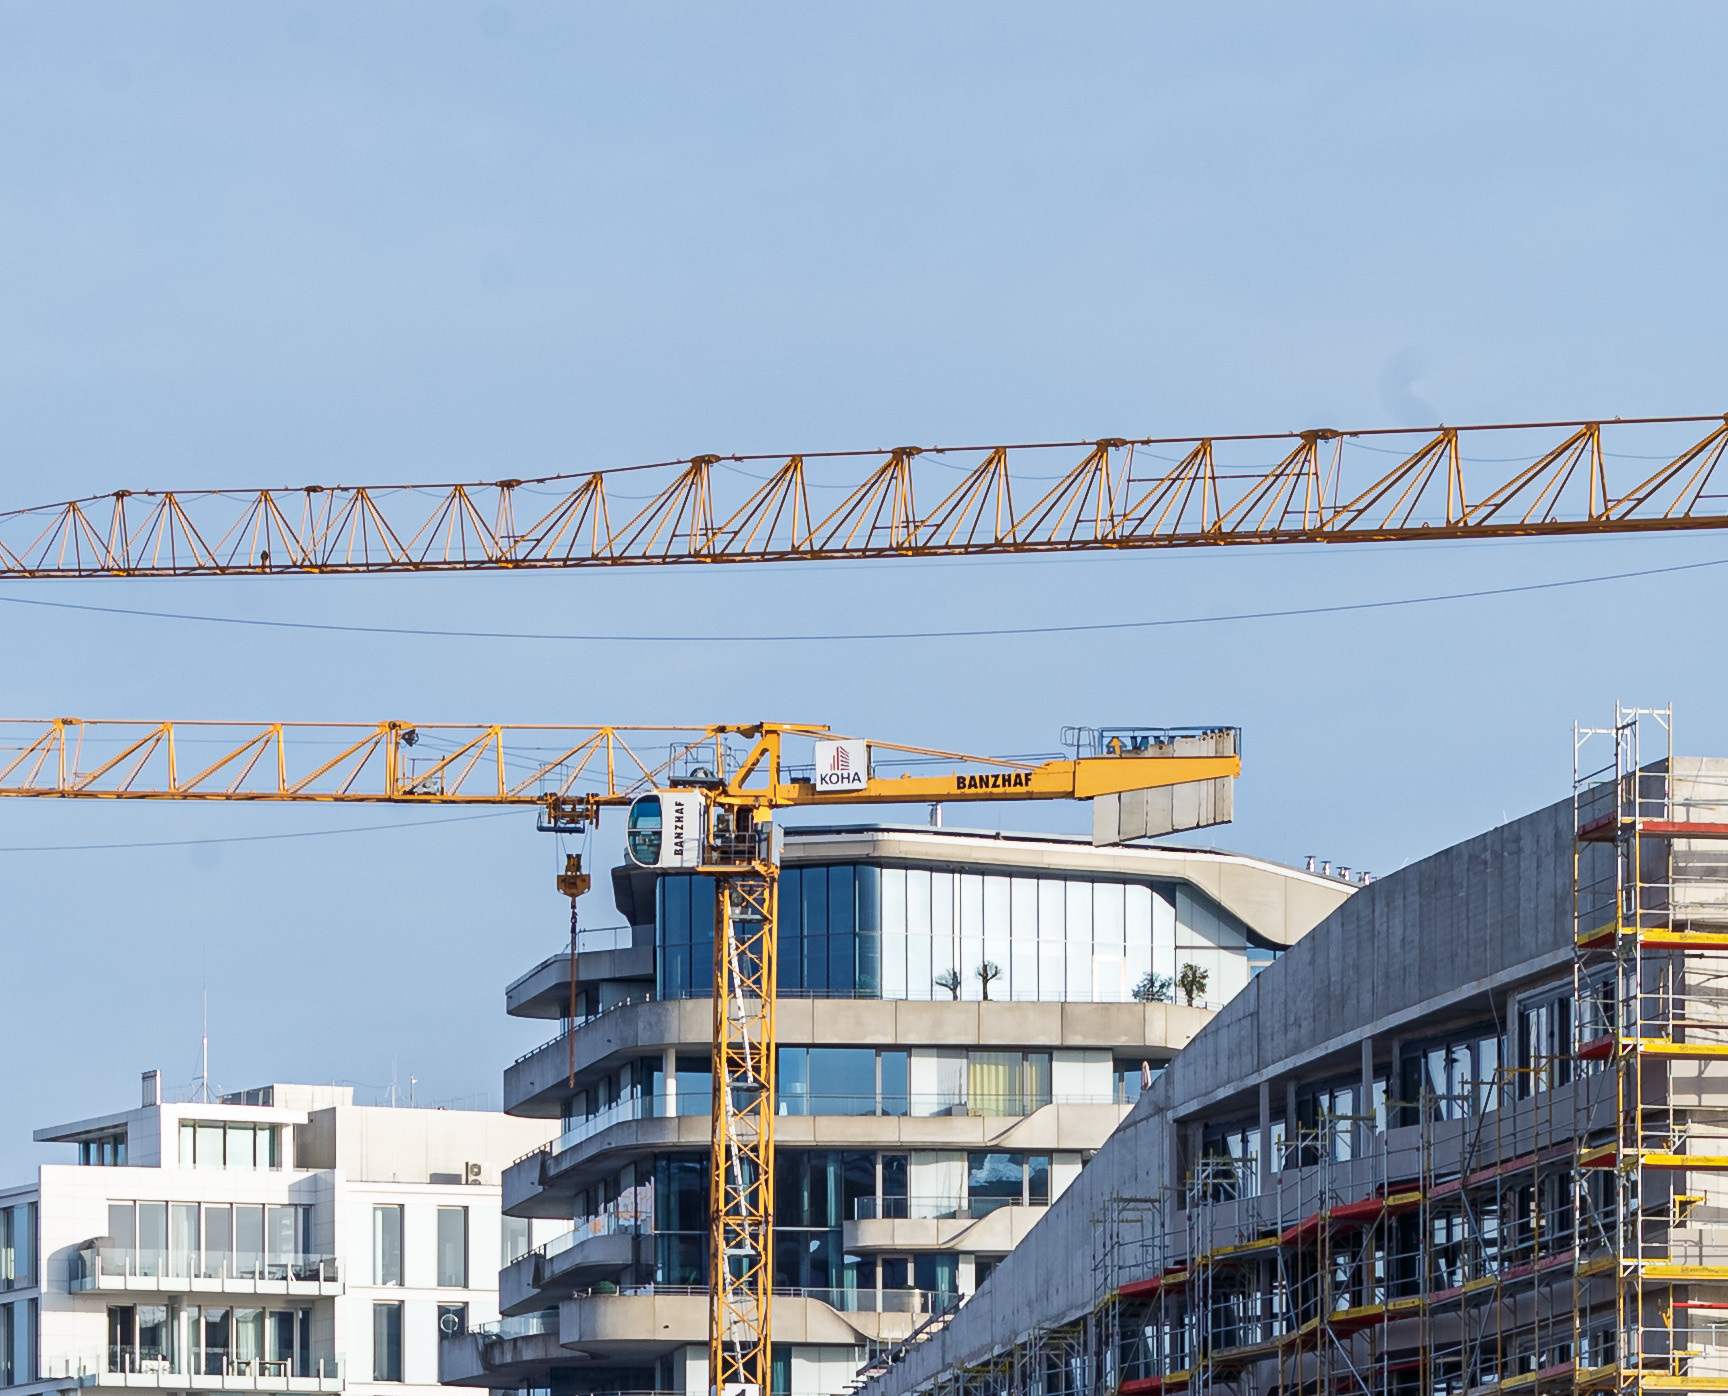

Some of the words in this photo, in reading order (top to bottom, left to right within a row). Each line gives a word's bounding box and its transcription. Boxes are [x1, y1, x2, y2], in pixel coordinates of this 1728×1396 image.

[820, 772, 862, 787] KOHA
[956, 772, 1033, 791] BANZHAF
[673, 800, 684, 857] BANZHAF
